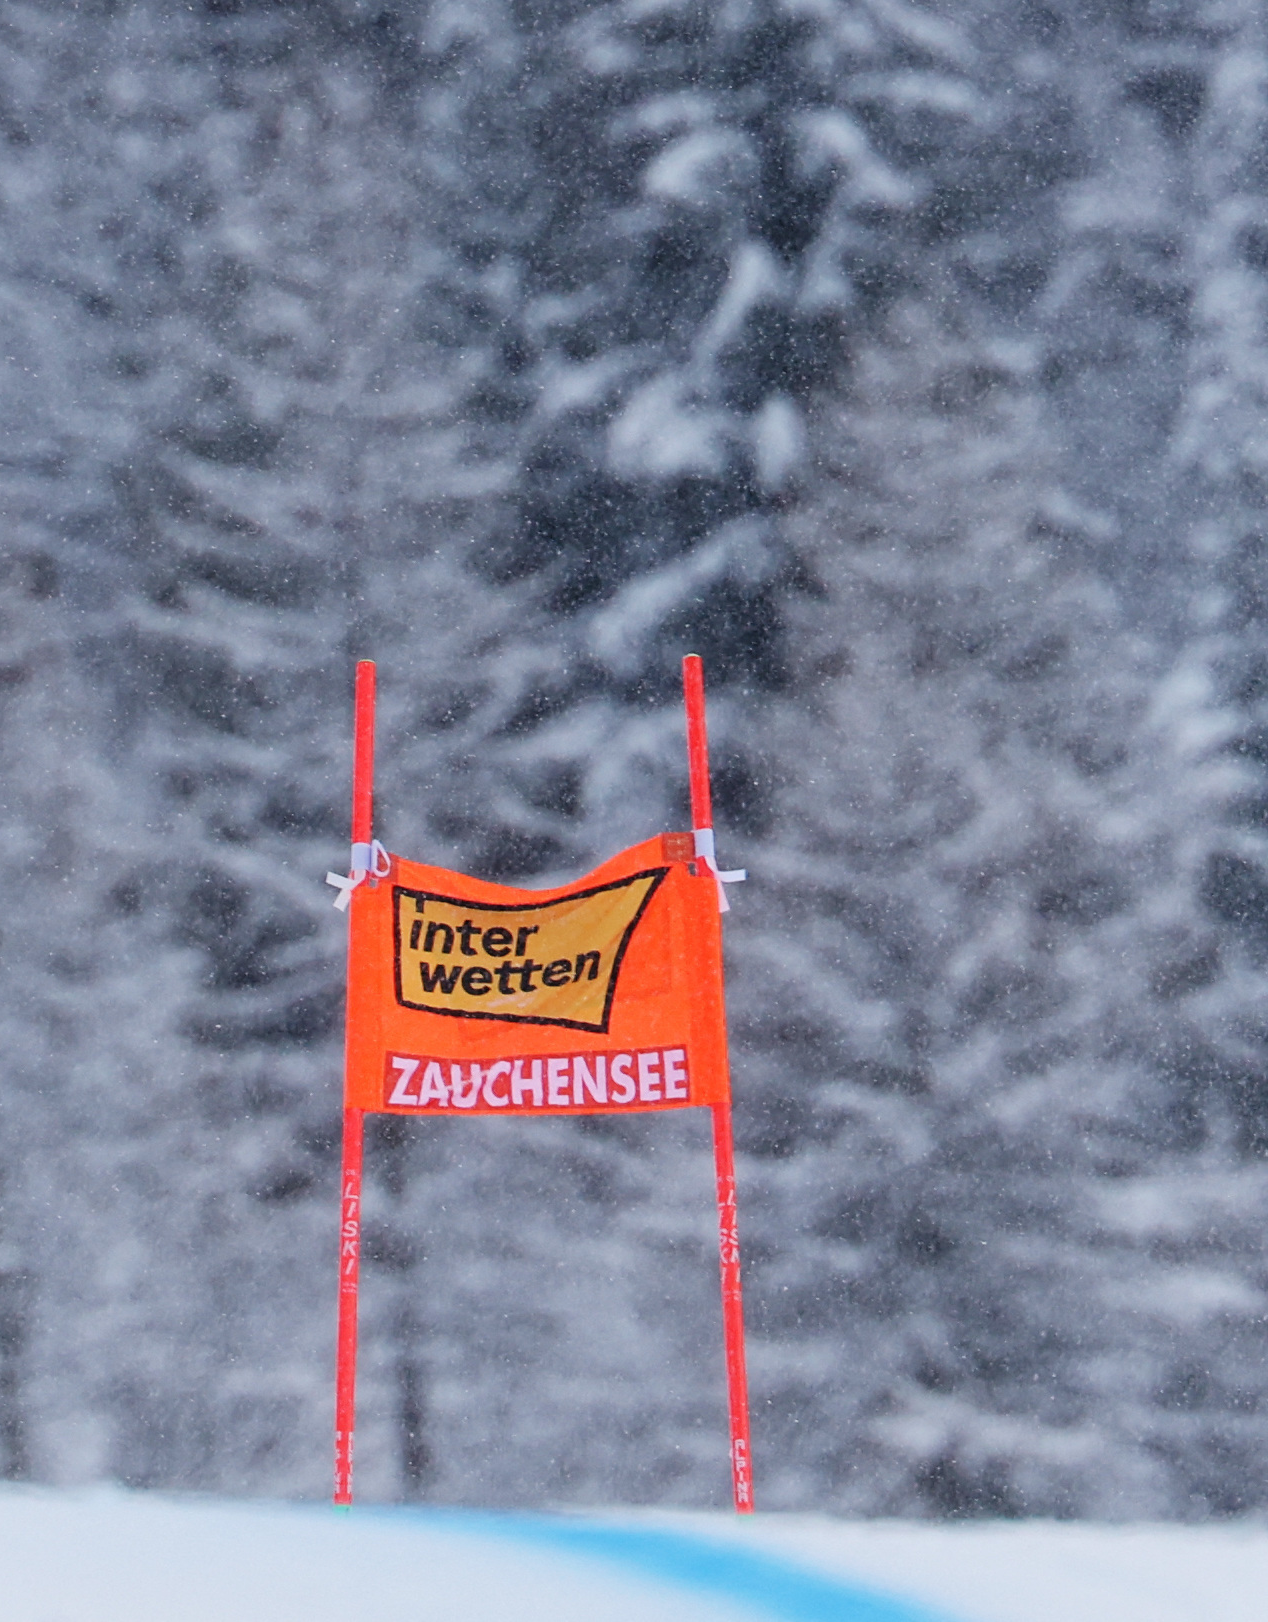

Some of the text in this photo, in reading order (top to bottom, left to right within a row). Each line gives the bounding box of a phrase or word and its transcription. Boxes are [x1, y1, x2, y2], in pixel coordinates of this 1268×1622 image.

[409, 902, 538, 957] inter
[419, 948, 601, 996] wetten
[388, 1049, 688, 1108] ZAUCHENSEE
[342, 1182, 359, 1275] LISKI
